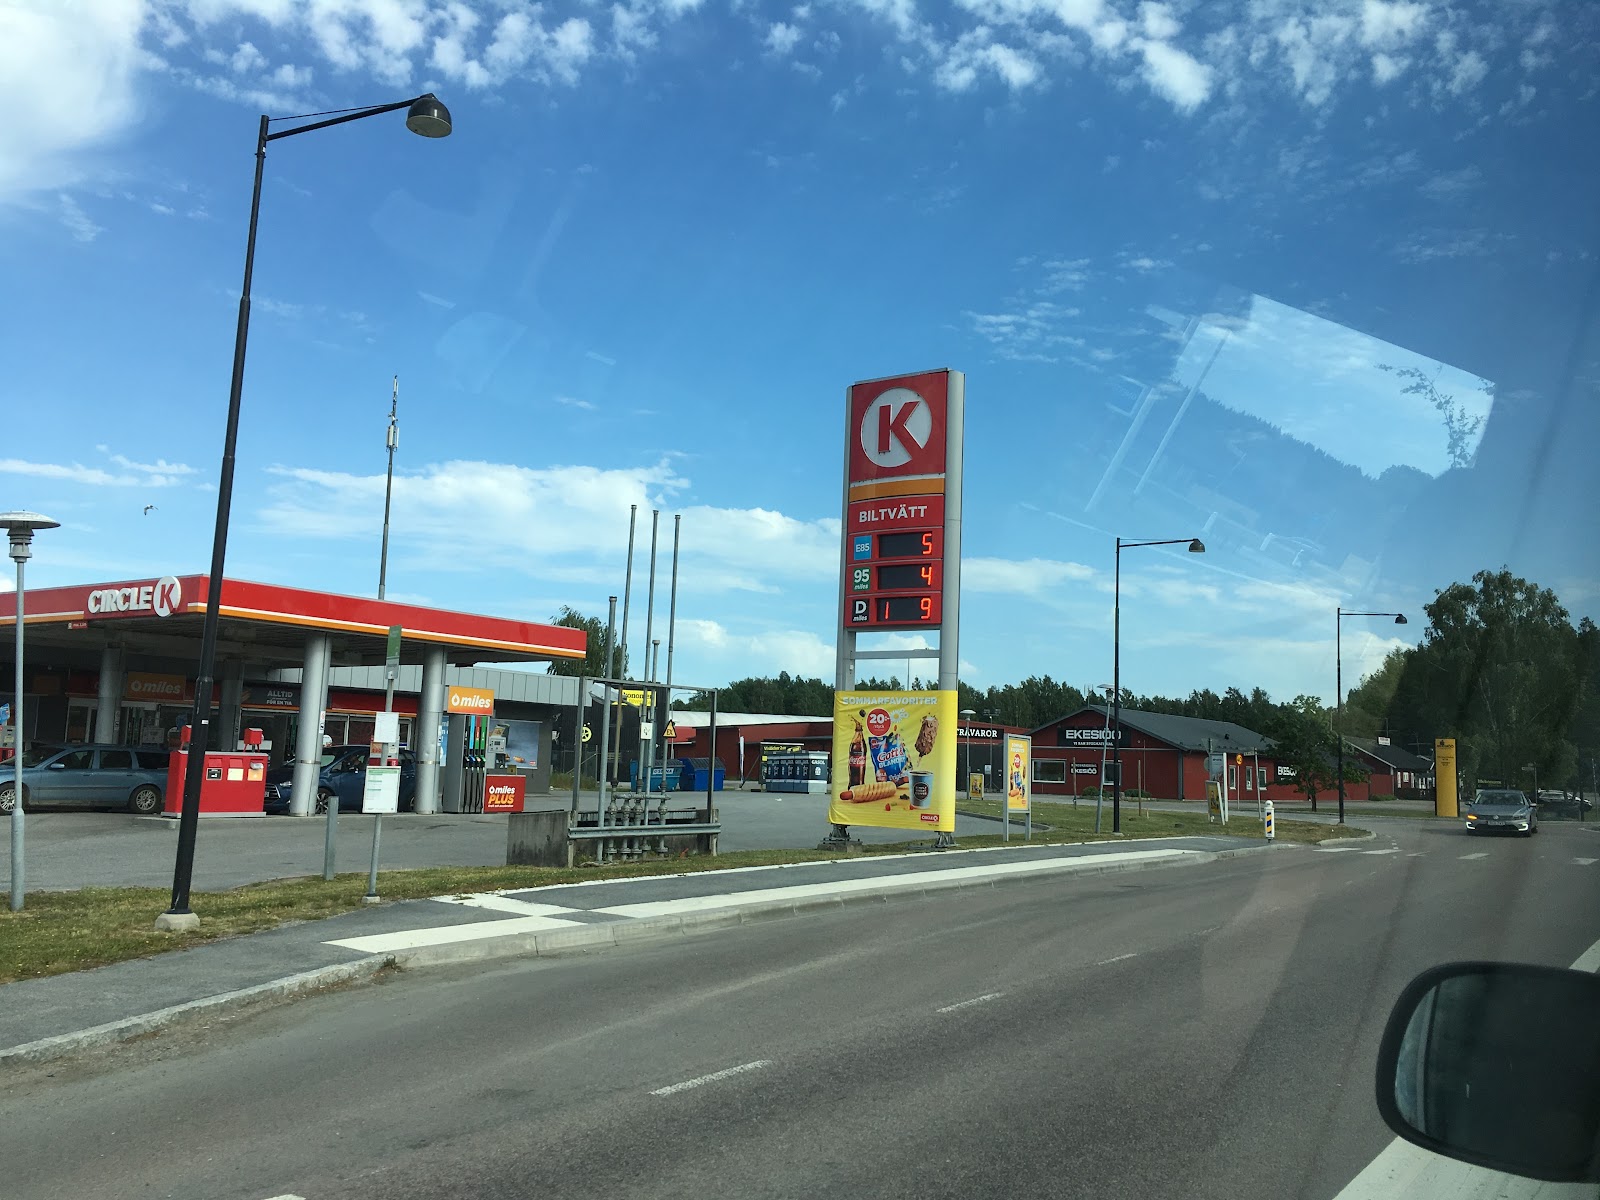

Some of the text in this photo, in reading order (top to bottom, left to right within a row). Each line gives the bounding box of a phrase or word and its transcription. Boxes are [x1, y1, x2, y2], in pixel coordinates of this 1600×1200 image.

[875, 398, 924, 461] K
[859, 504, 928, 523] BILTVÄTT
[855, 543, 870, 553] E85
[922, 533, 932, 555] 5
[854, 569, 870, 583] 95
[921, 566, 932, 586] 4
[854, 583, 869, 591] miles
[87, 580, 179, 616] CIRCLE K
[855, 601, 867, 614] D
[853, 614, 867, 622] miles
[141, 680, 182, 695] miles
[267, 690, 293, 698] ALLTID
[460, 695, 491, 708] miles
[842, 696, 938, 705] SOMMARFAVORITER
[494, 785, 515, 794] miles
[488, 794, 515, 804] PLUS
